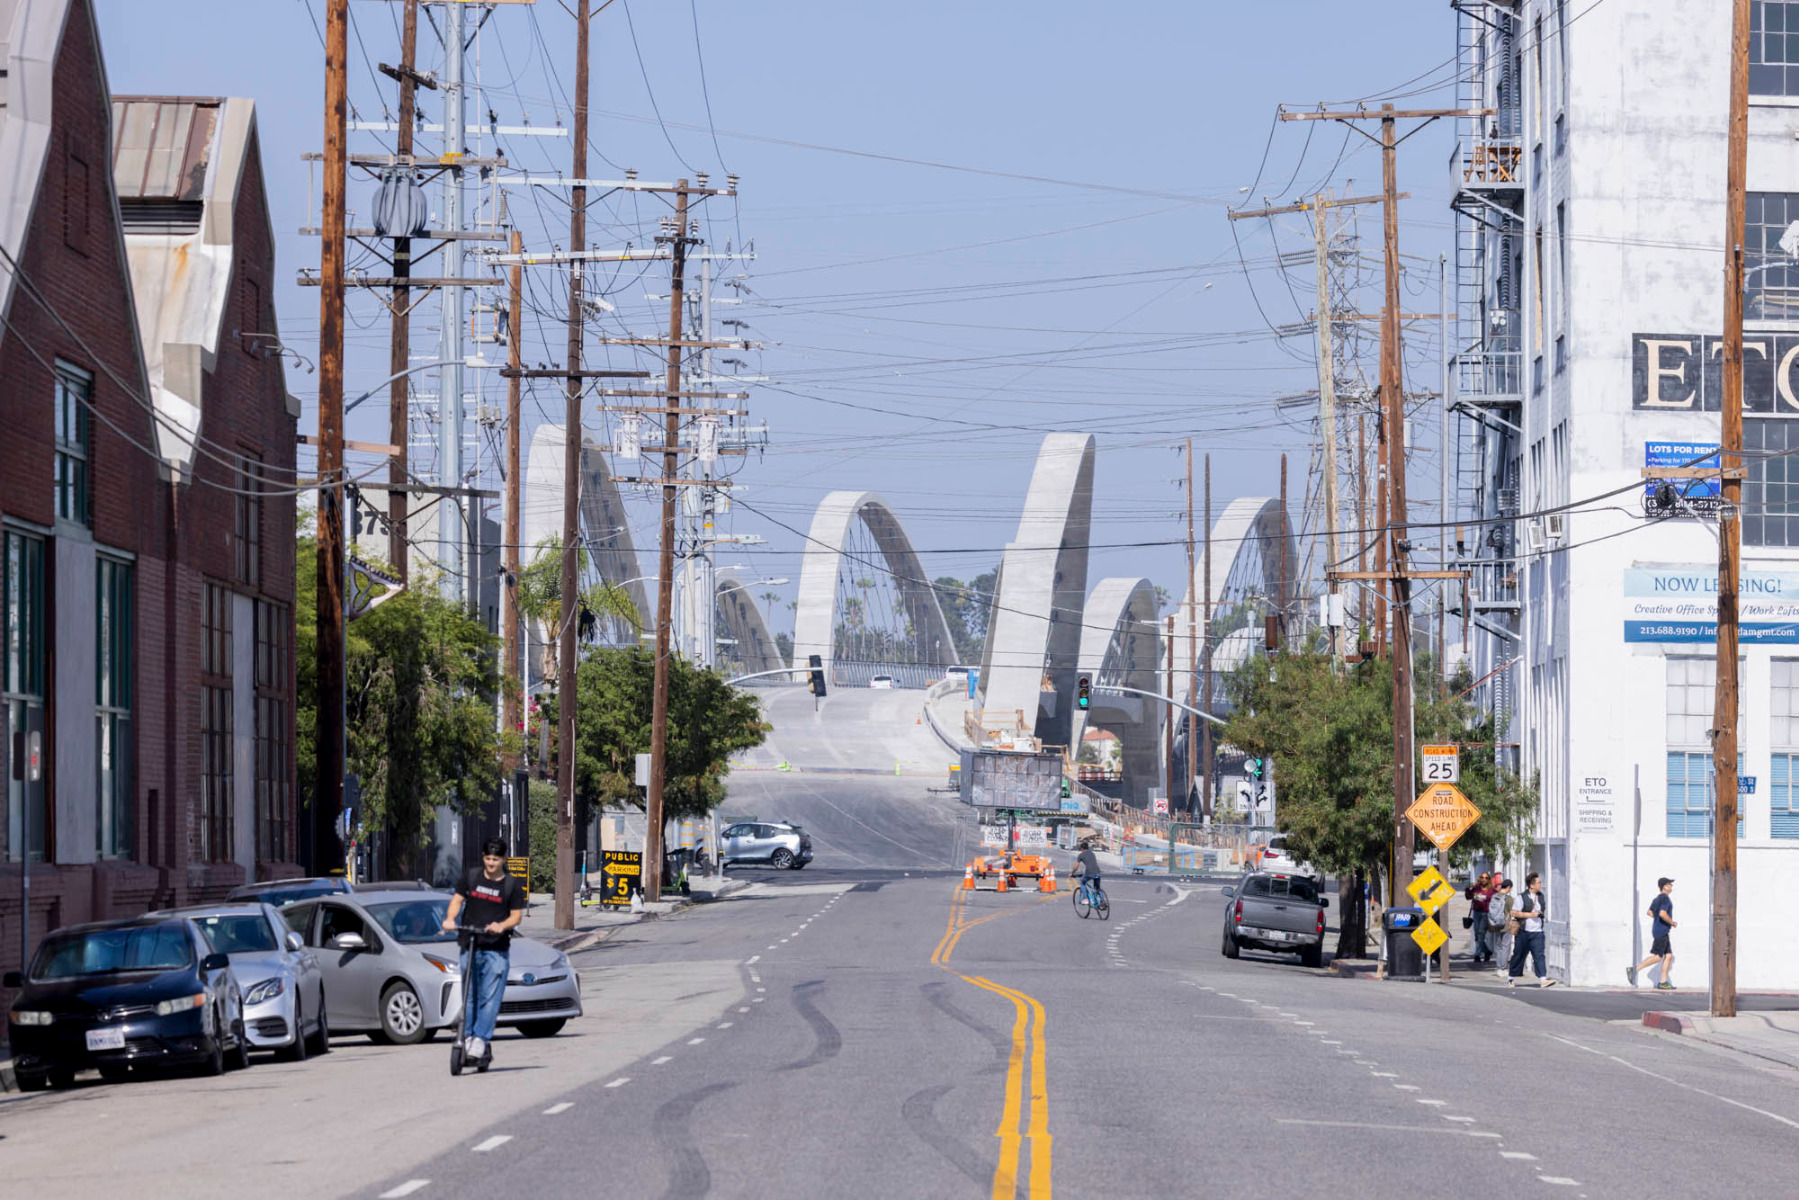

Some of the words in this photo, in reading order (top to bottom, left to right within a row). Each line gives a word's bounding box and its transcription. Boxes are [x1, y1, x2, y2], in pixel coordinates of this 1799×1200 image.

[1649, 445, 1672, 454] LOTS
[1673, 446, 1692, 454] FOR
[1654, 577, 1699, 592] NOW
[1704, 578, 1782, 594] LESING!
[1634, 604, 1673, 615] Creative
[1675, 604, 1705, 616] Office
[1748, 606, 1775, 616] Work
[1640, 626, 1698, 636] 213.688.9190
[1428, 763, 1453, 779] 25
[1585, 777, 1607, 787] ETO
[1432, 796, 1454, 805] ROAD
[1413, 809, 1473, 818] CONSTRUCTION
[1579, 816, 1612, 824] RECEIVING
[1430, 821, 1457, 831] AHEAD
[605, 852, 639, 861] PUBLIC
[606, 877, 614, 889] $
[617, 877, 629, 895] 5
